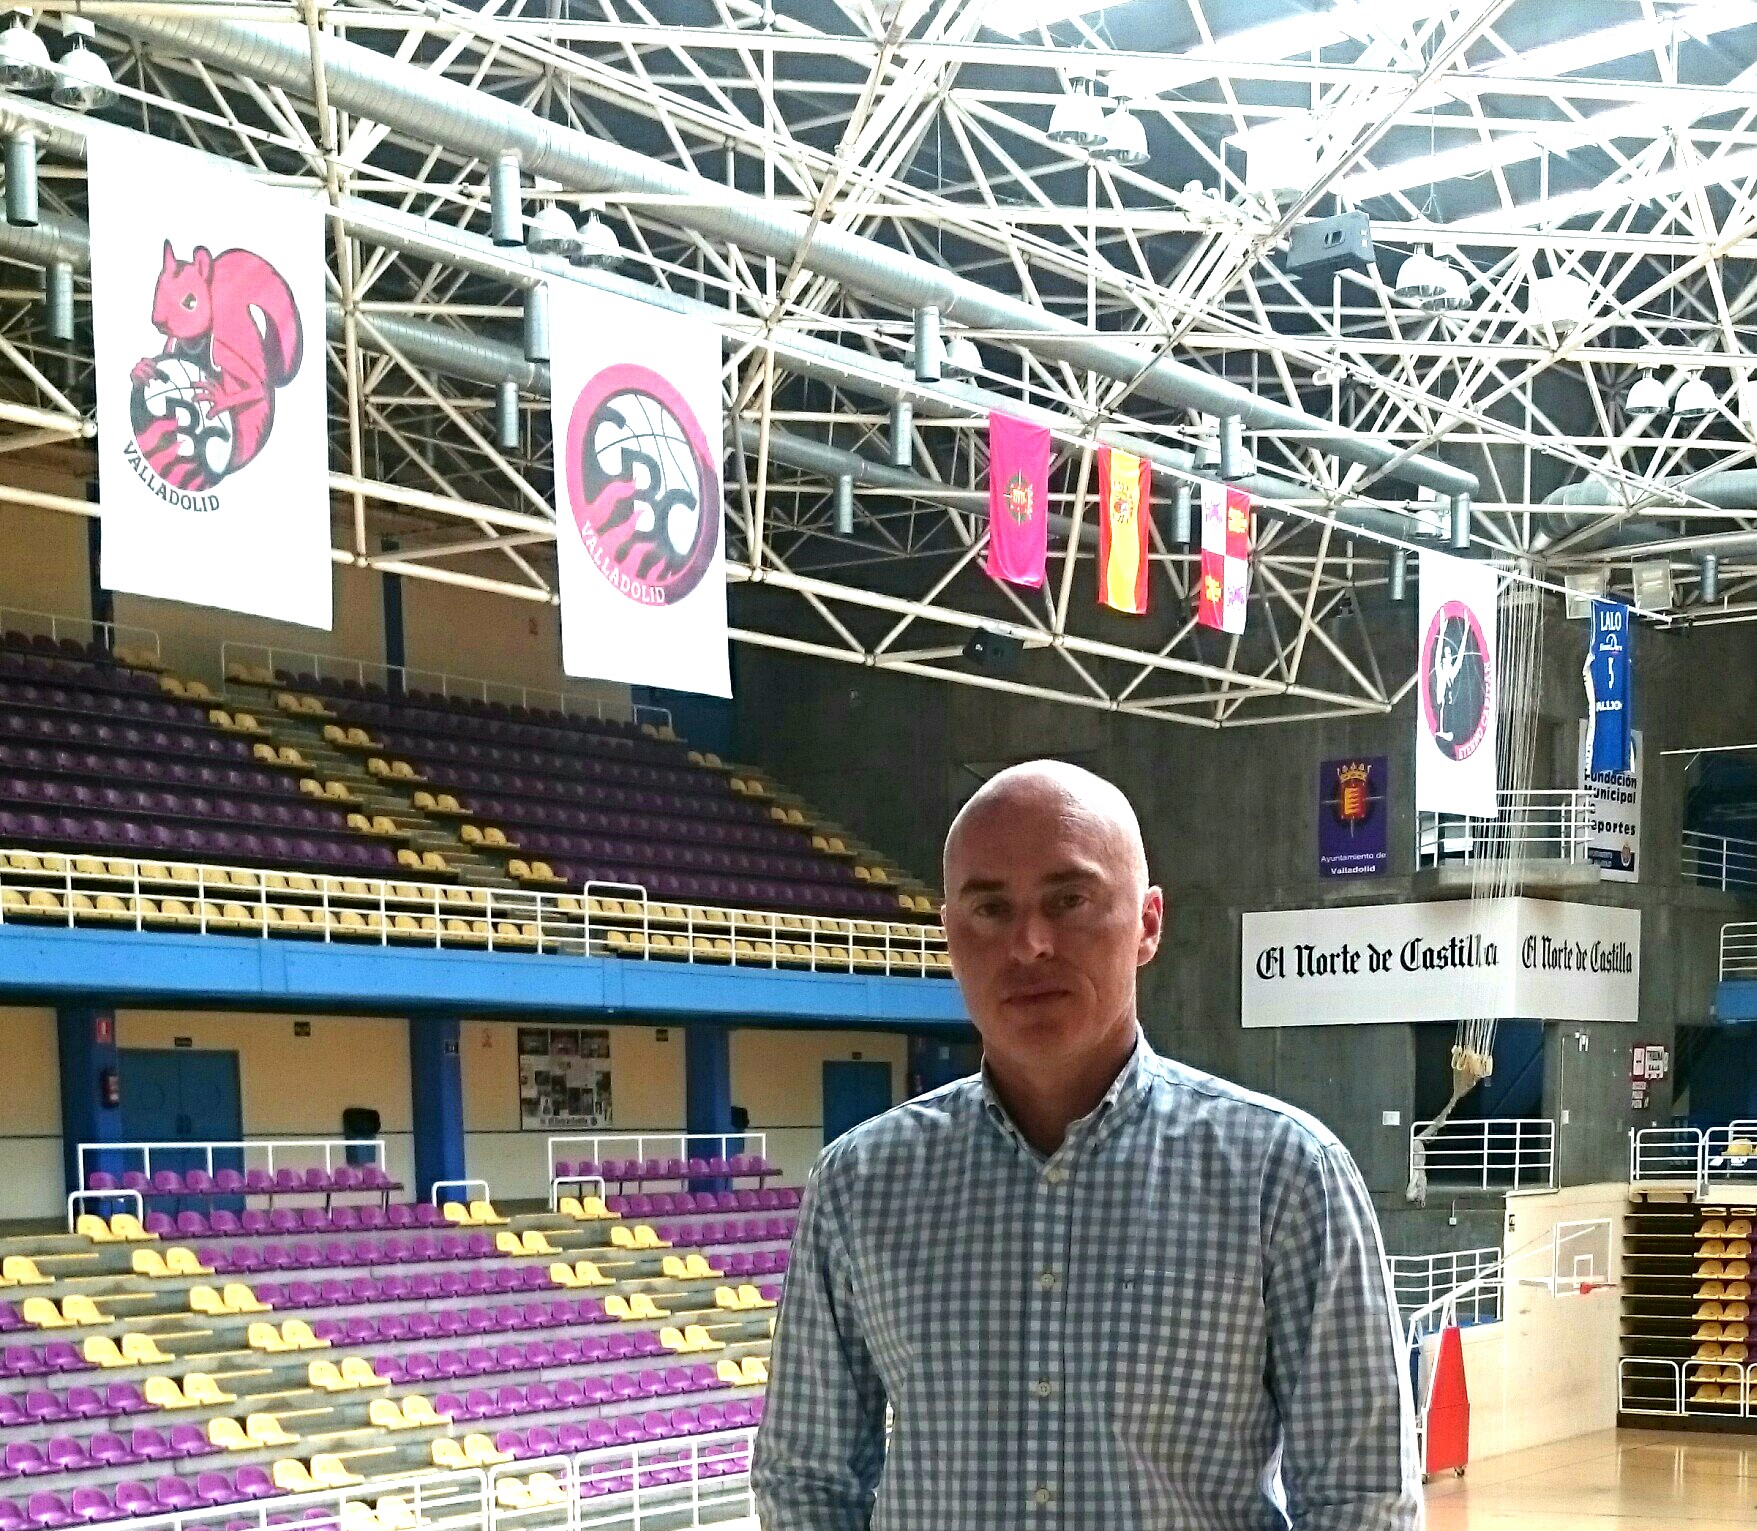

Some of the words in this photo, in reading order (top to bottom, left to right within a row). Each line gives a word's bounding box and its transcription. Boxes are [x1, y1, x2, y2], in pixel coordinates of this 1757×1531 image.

[123, 439, 220, 512] VALLADOLID
[582, 405, 698, 558] CBC
[581, 520, 665, 603] VALLADOLID
[1600, 611, 1622, 631] LALO
[1607, 656, 1615, 689] 5
[1584, 817, 1636, 836] eportes
[1320, 853, 1374, 863] Ayuntamiento
[1375, 851, 1387, 859] de
[1330, 864, 1376, 874] Valladolid
[1256, 945, 1286, 980] El
[1294, 943, 1361, 978] Norte
[1367, 942, 1393, 973] de
[1399, 934, 1499, 972] Castilla
[1521, 935, 1537, 969] El
[1541, 935, 1573, 971] Norte
[1575, 941, 1588, 972] de
[1590, 940, 1632, 973] Castilla
